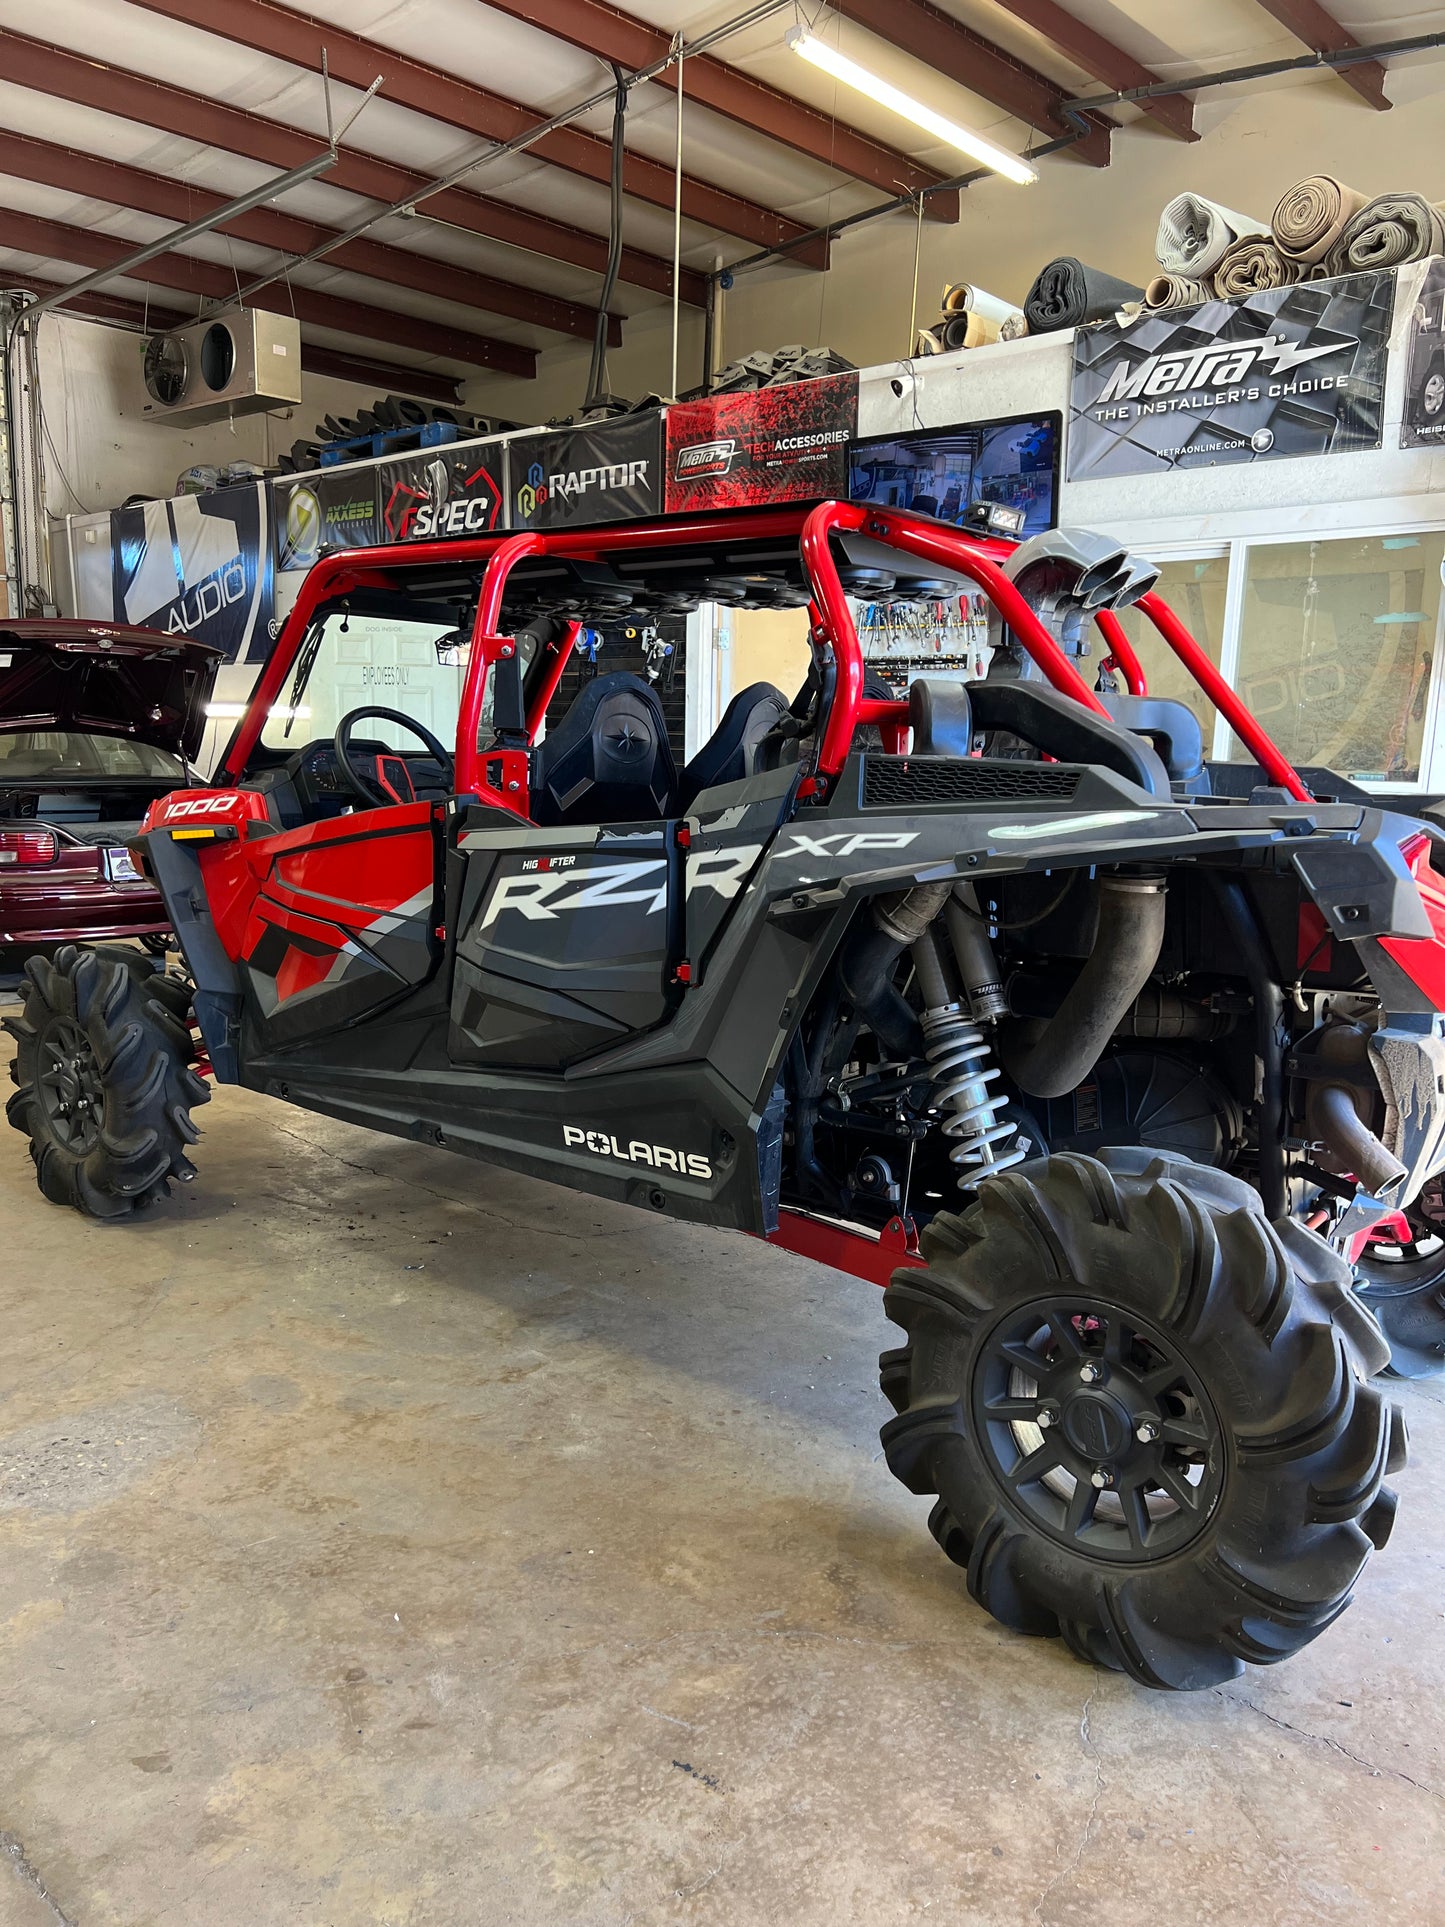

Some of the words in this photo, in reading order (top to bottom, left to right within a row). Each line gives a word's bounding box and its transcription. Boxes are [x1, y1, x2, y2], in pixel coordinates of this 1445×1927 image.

[1095, 406, 1129, 421] THE
[1137, 387, 1260, 416] INSTALLER'S
[1268, 374, 1349, 397] CHOICE
[752, 454, 765, 462] FOR
[766, 453, 782, 461] YOUR
[1156, 439, 1245, 457] METRAONLINE.COM
[549, 460, 652, 504] RAPTOR
[679, 461, 726, 476] POWERSPORTS
[168, 563, 247, 633] AUDIO
[164, 796, 238, 819] 1000
[771, 832, 922, 859] XP
[562, 1124, 713, 1179] POLARIS
